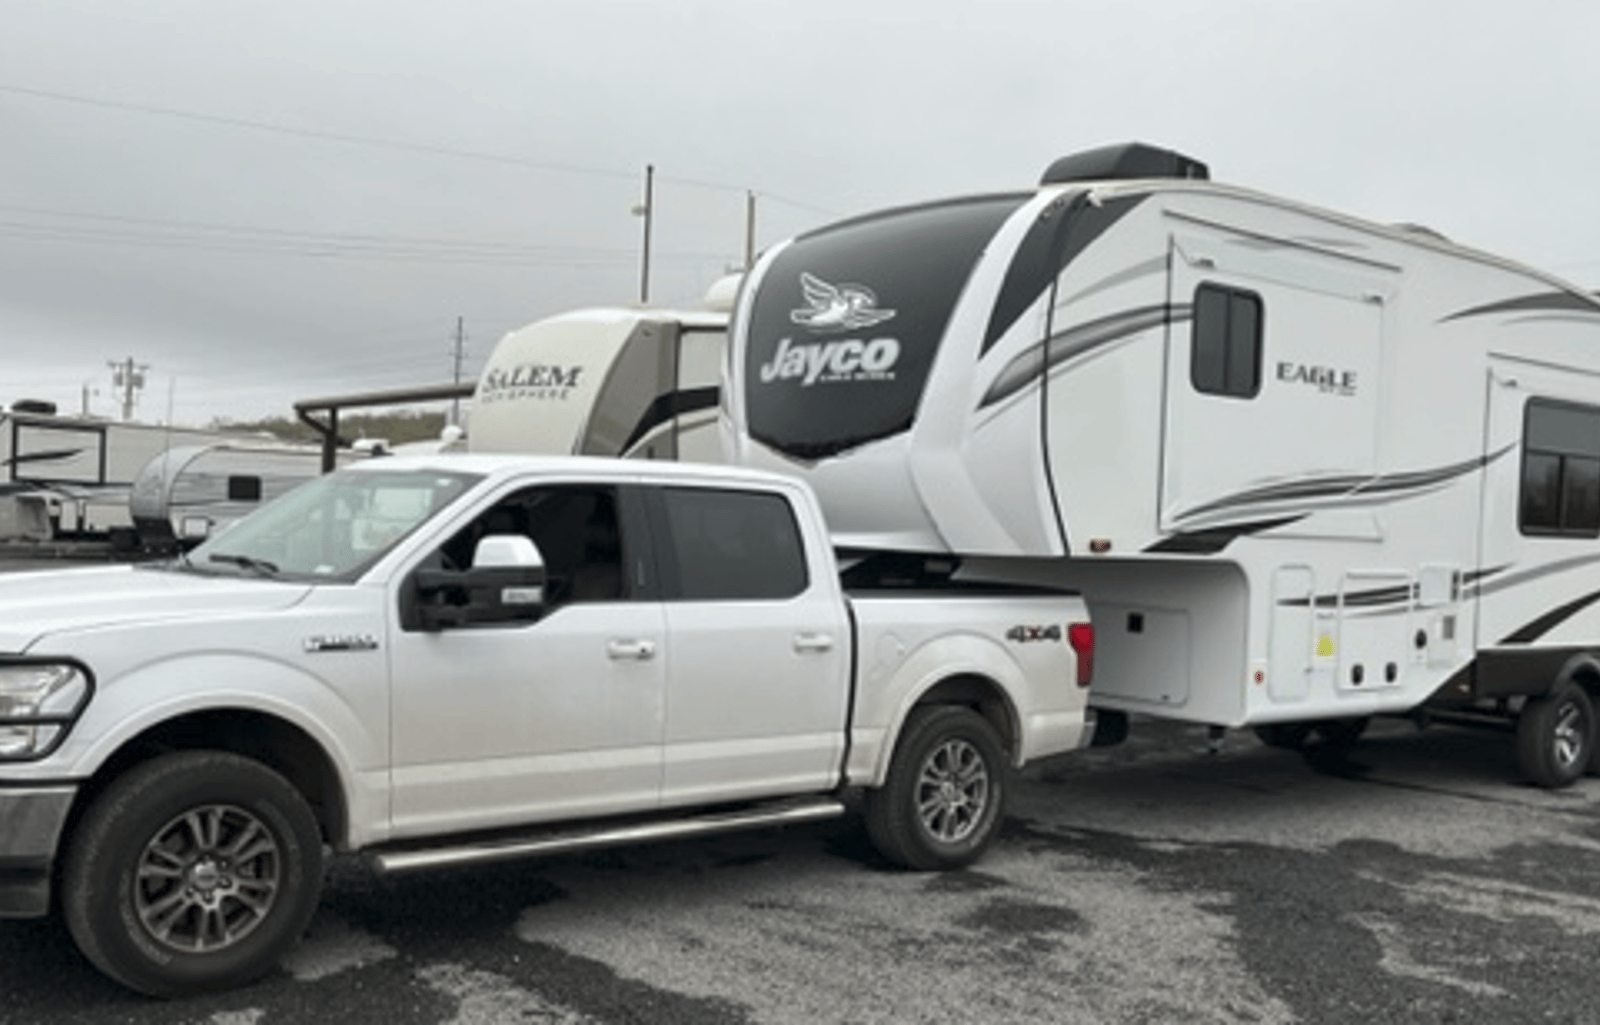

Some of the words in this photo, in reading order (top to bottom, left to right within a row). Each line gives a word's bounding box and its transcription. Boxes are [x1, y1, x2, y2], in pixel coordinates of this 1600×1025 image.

[760, 337, 900, 386] Jayco
[1277, 361, 1357, 390] EAGLE
[482, 366, 582, 393] SALEM
